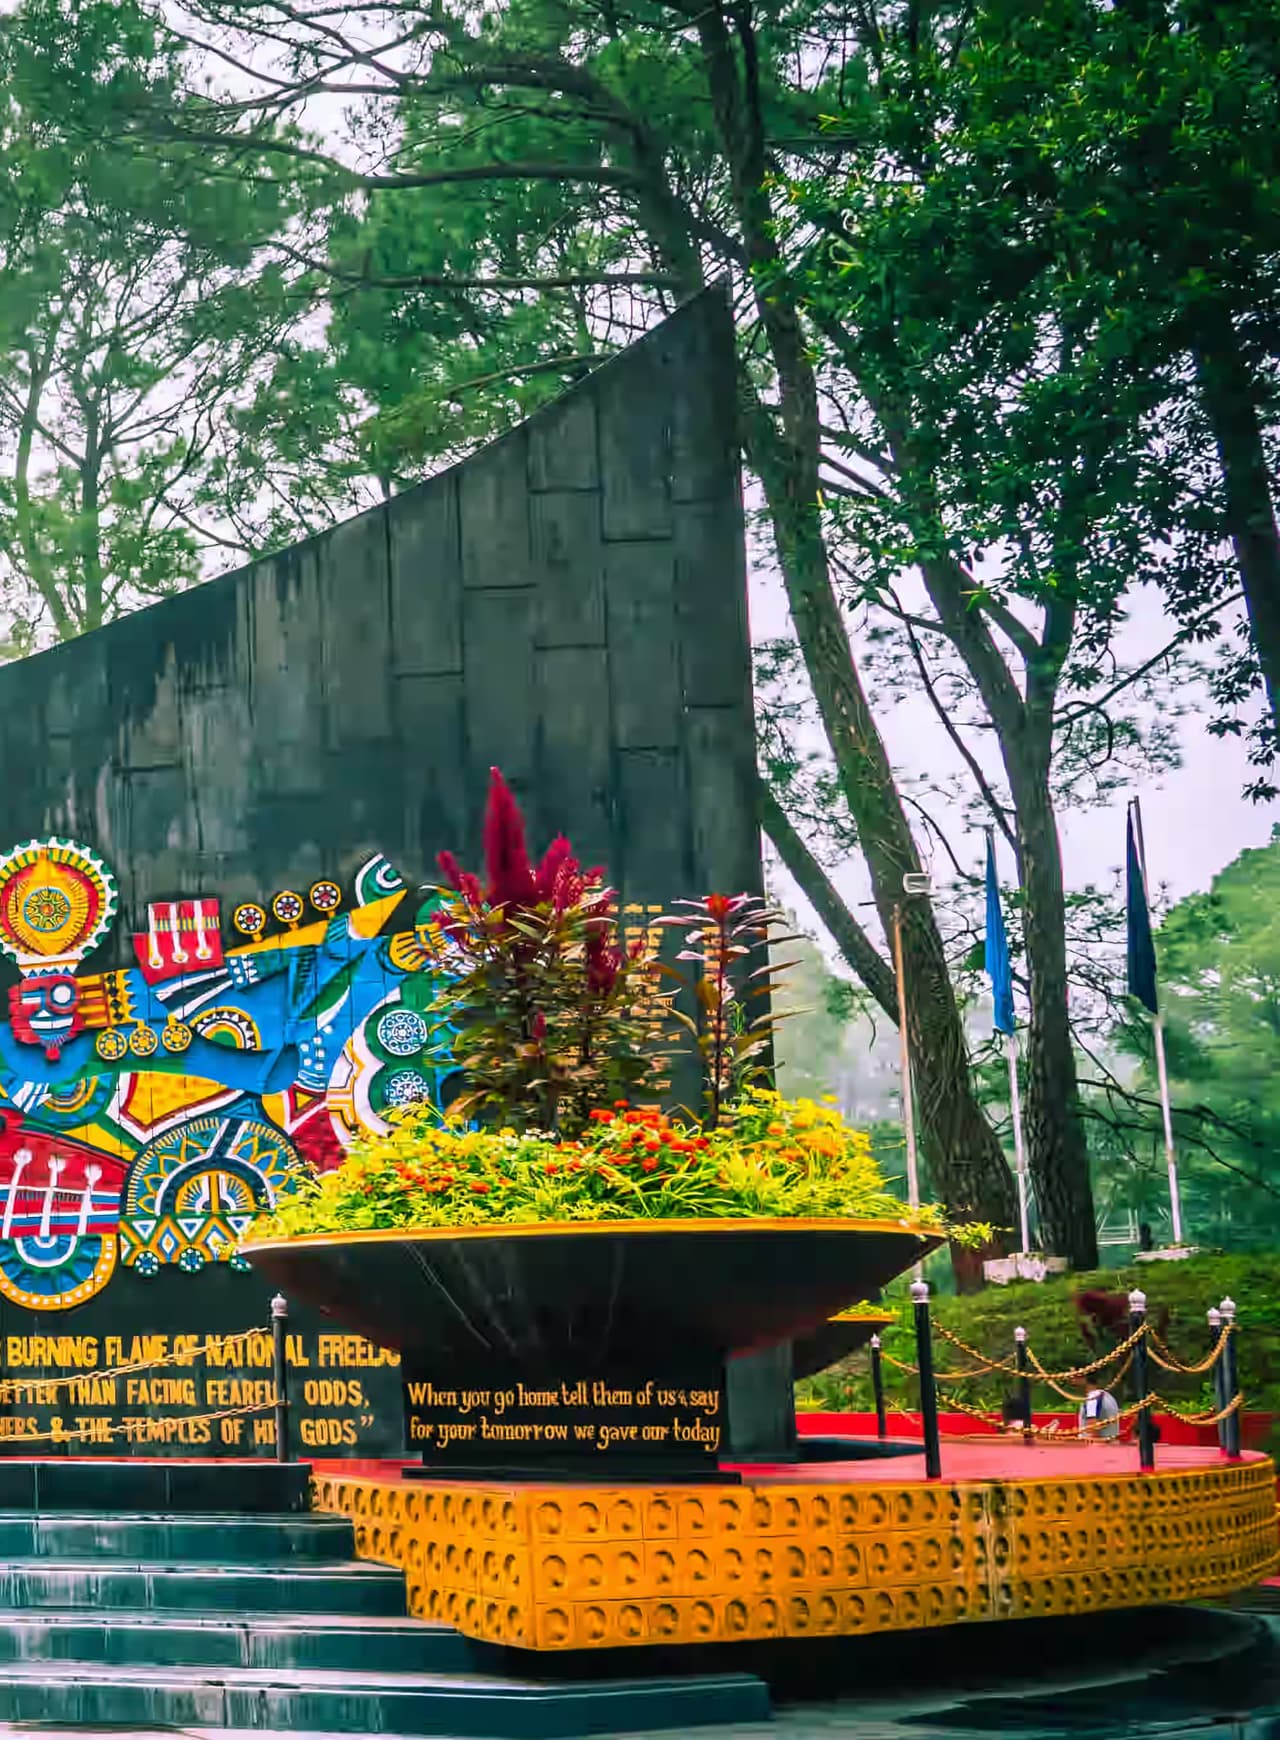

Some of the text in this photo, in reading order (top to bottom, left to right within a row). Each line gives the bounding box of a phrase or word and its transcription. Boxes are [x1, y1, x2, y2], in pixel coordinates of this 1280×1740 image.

[6, 1335, 98, 1368] BURNING
[173, 1335, 200, 1367] OF
[68, 1379, 116, 1405] THAN
[127, 1378, 196, 1406] FACING
[206, 1379, 278, 1406] FEARFU
[303, 1378, 370, 1408] ODDS,
[408, 1382, 458, 1406] When
[459, 1389, 490, 1413] you
[494, 1389, 515, 1415] go
[516, 1382, 560, 1407] home
[561, 1380, 588, 1406] tell
[592, 1380, 633, 1407] them
[636, 1380, 654, 1406] of
[690, 1389, 720, 1415] say
[50, 1416, 71, 1443] &
[75, 1417, 113, 1443] THE
[122, 1417, 211, 1444] TEMPLES
[221, 1418, 244, 1444] OF
[410, 1416, 720, 1452] for your tomorrow we gave our today
